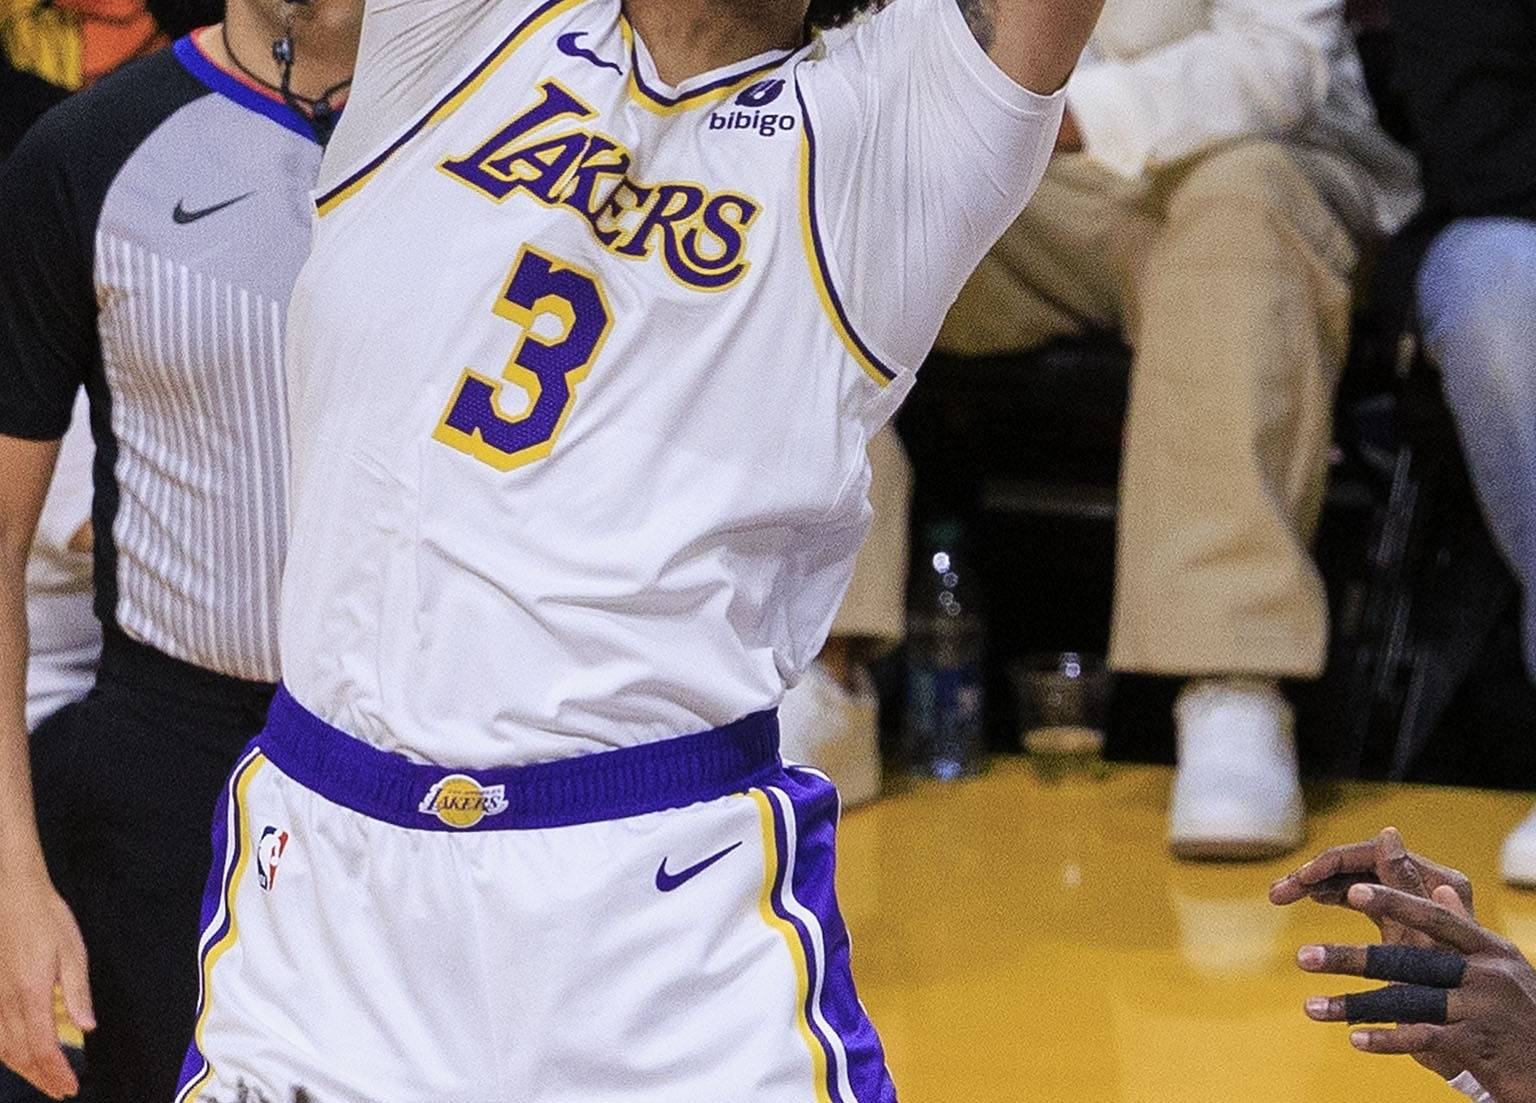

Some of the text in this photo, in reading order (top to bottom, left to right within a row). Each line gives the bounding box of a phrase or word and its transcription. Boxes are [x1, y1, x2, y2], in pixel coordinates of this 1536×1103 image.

[434, 77, 763, 292] LAKERS
[709, 110, 796, 137] bibigo
[431, 242, 615, 473] 3
